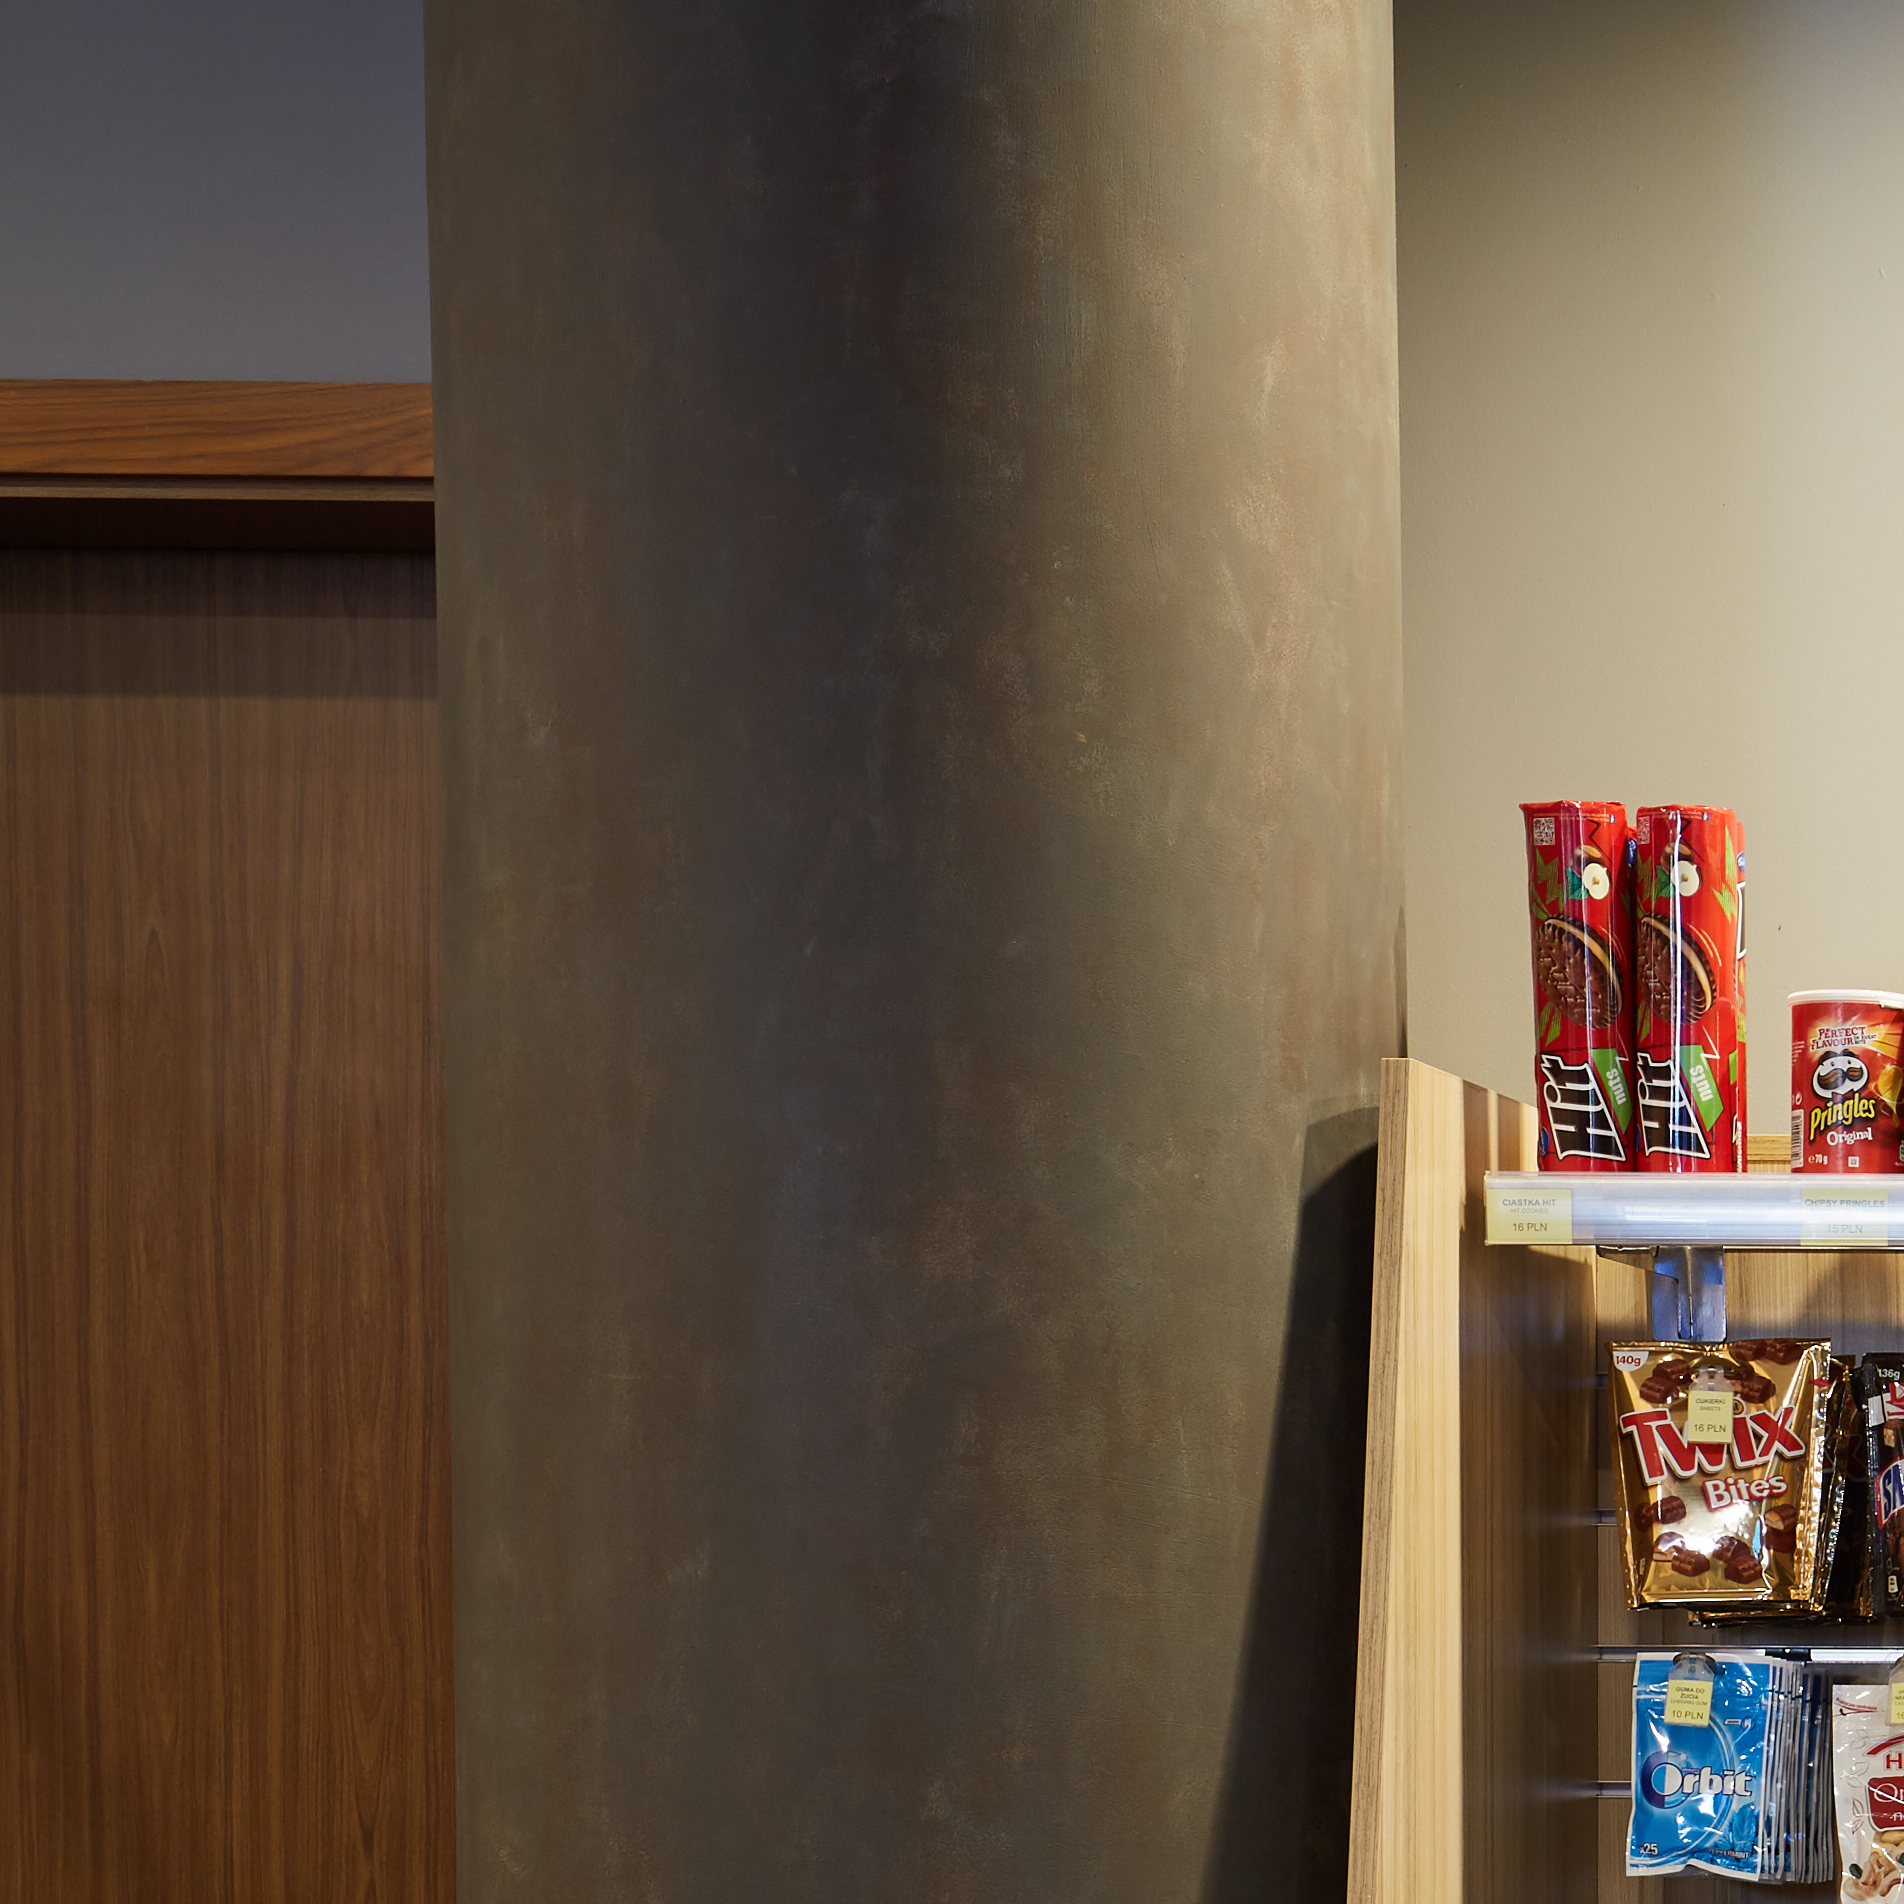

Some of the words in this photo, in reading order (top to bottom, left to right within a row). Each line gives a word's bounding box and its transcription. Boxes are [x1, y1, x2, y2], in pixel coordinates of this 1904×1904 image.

[1539, 1052, 1627, 1162] Hit
[1636, 1051, 1711, 1159] Hit
[1809, 1094, 1877, 1142] Pringles
[1826, 1127, 1874, 1146] Original
[1614, 1353, 1641, 1367] 140g
[1703, 1474, 1788, 1510] Bites
[1649, 1760, 1755, 1798] Orbit
